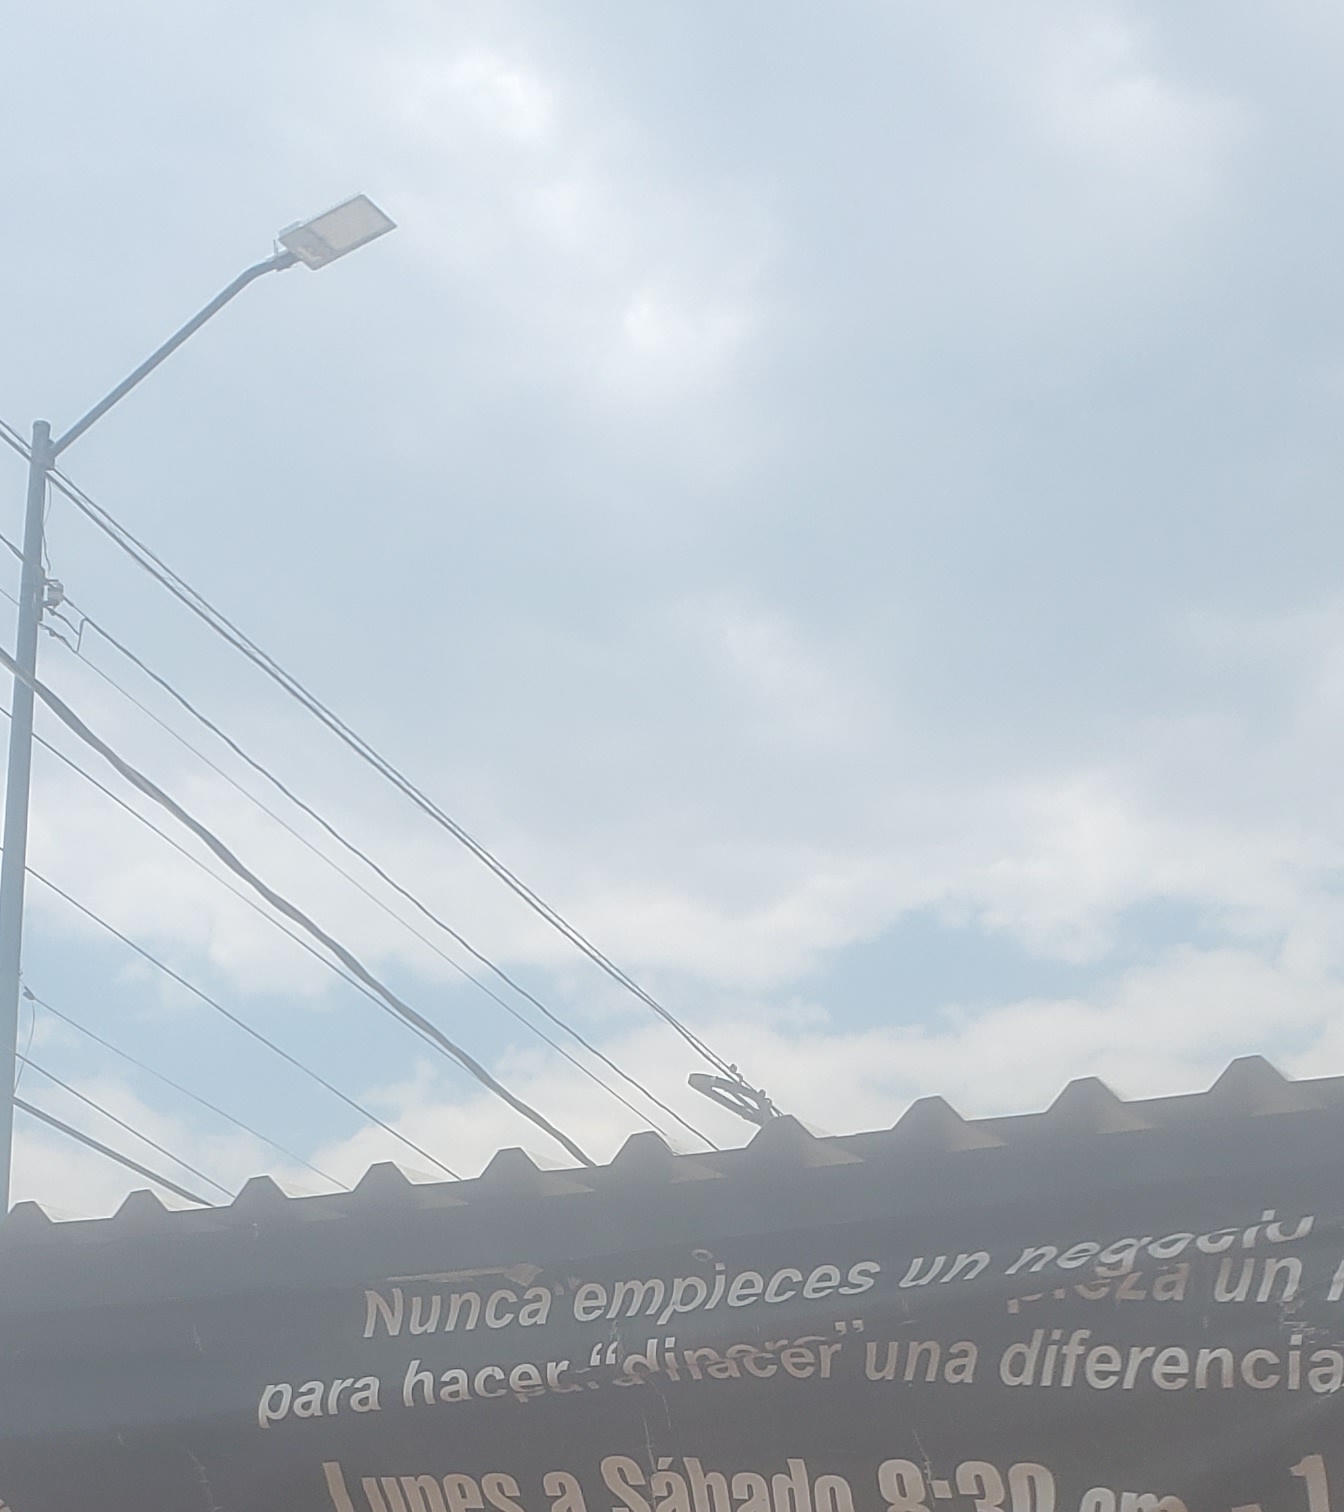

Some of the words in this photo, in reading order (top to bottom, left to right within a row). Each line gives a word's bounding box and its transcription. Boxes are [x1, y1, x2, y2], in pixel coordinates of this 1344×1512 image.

[363, 1286, 552, 1339] Nunca
[573, 1260, 880, 1326] empieces
[899, 1249, 991, 1288] un
[258, 1373, 381, 1429] para
[1214, 1257, 1303, 1303] un
[865, 1338, 976, 1386] una
